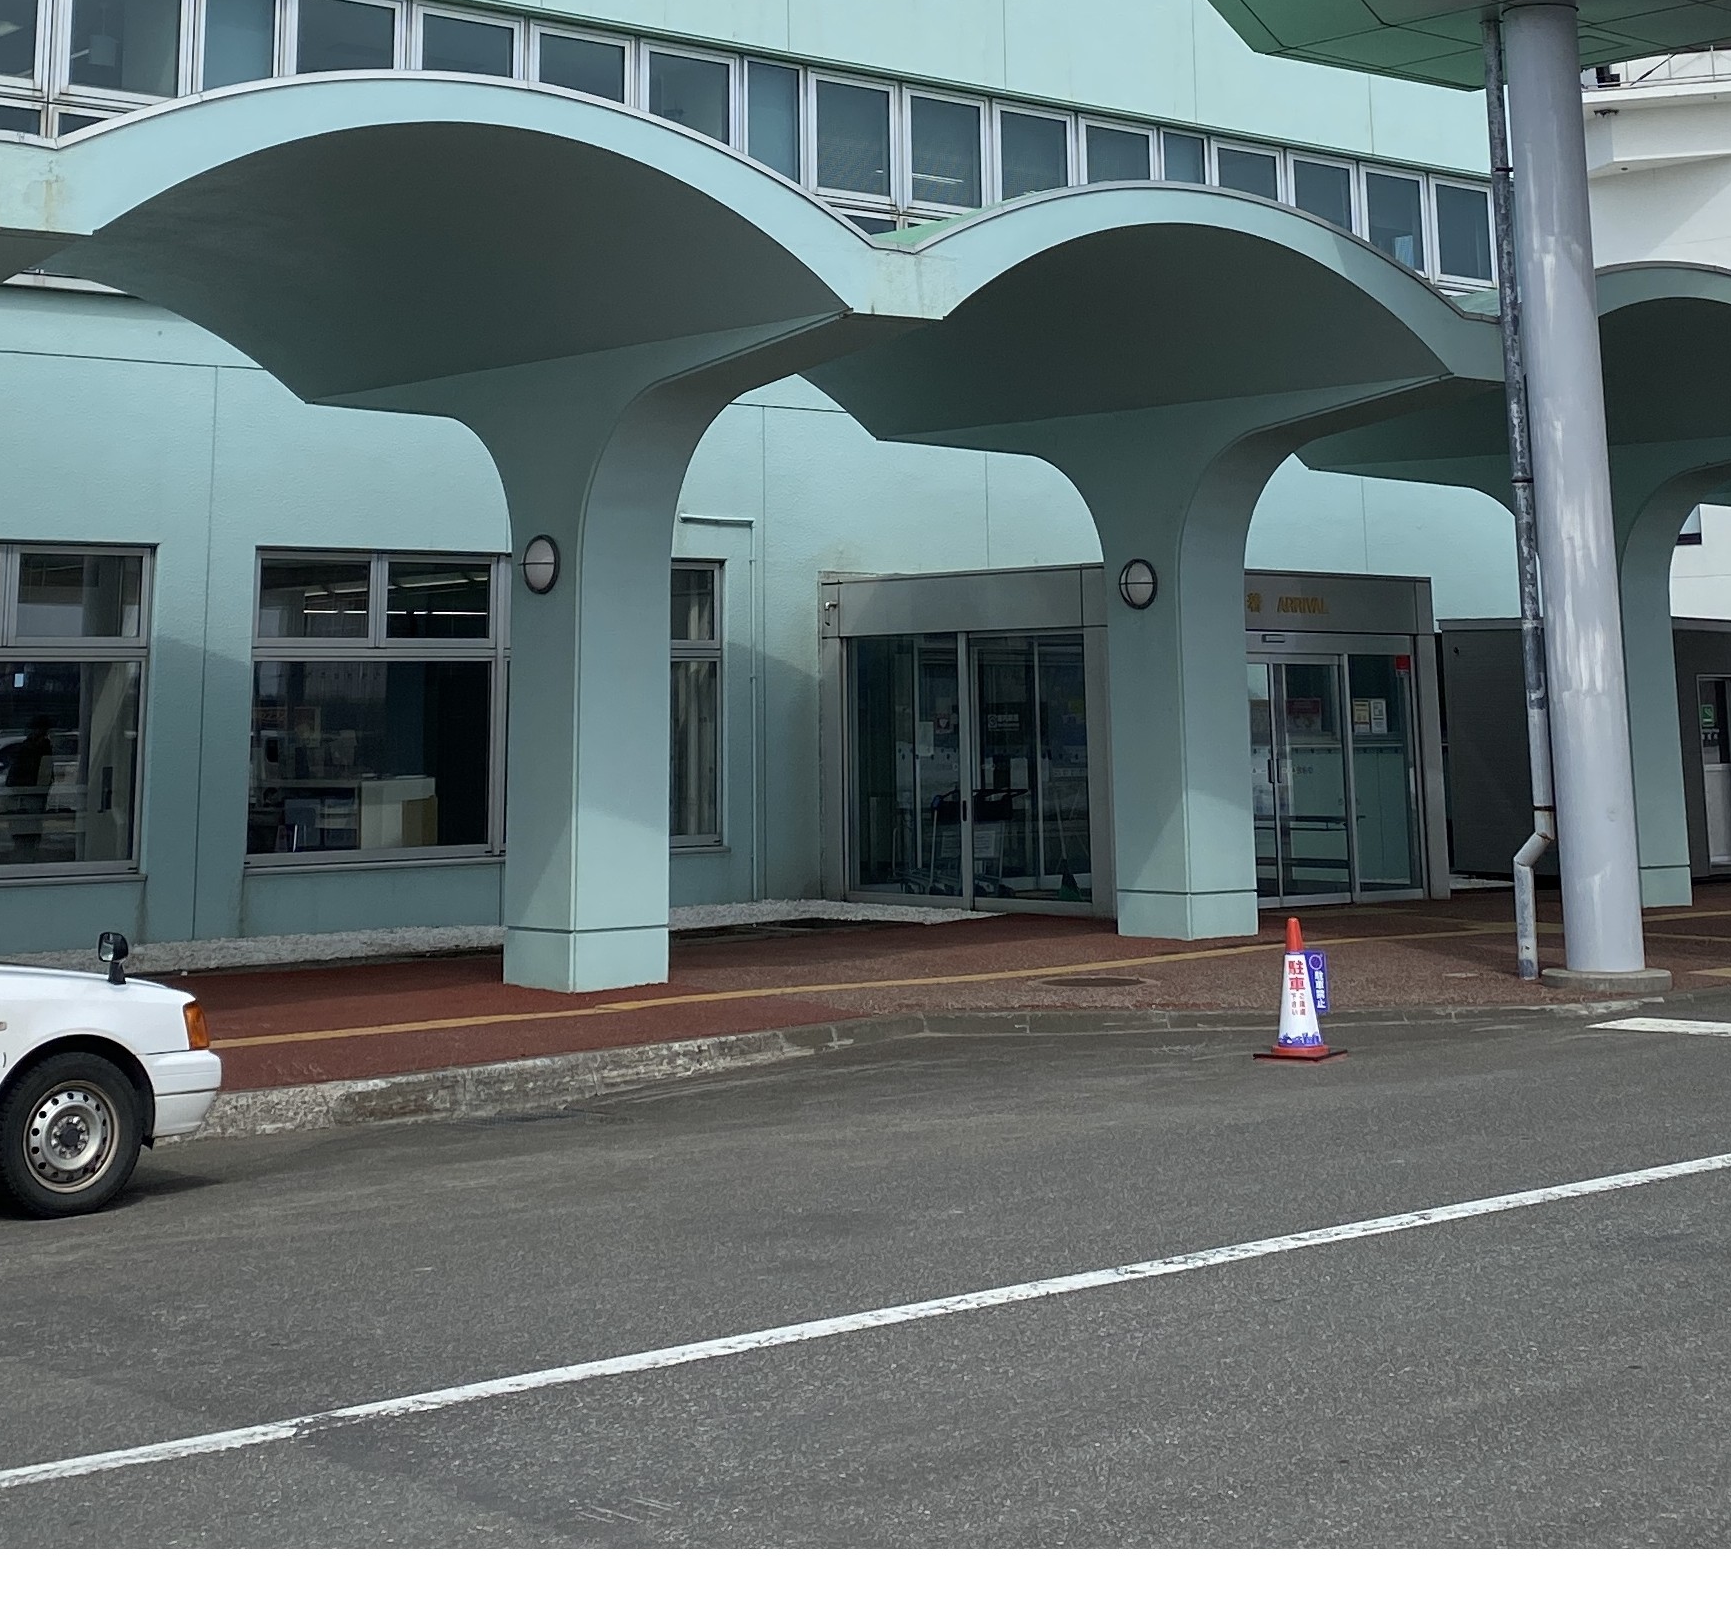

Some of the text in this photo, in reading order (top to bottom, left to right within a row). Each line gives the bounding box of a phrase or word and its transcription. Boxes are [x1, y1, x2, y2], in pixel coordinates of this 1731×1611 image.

[1277, 596, 1329, 614] ARRIVAL
[1288, 959, 1306, 992] 駐車
[1314, 970, 1327, 1009] 駐車禁止
